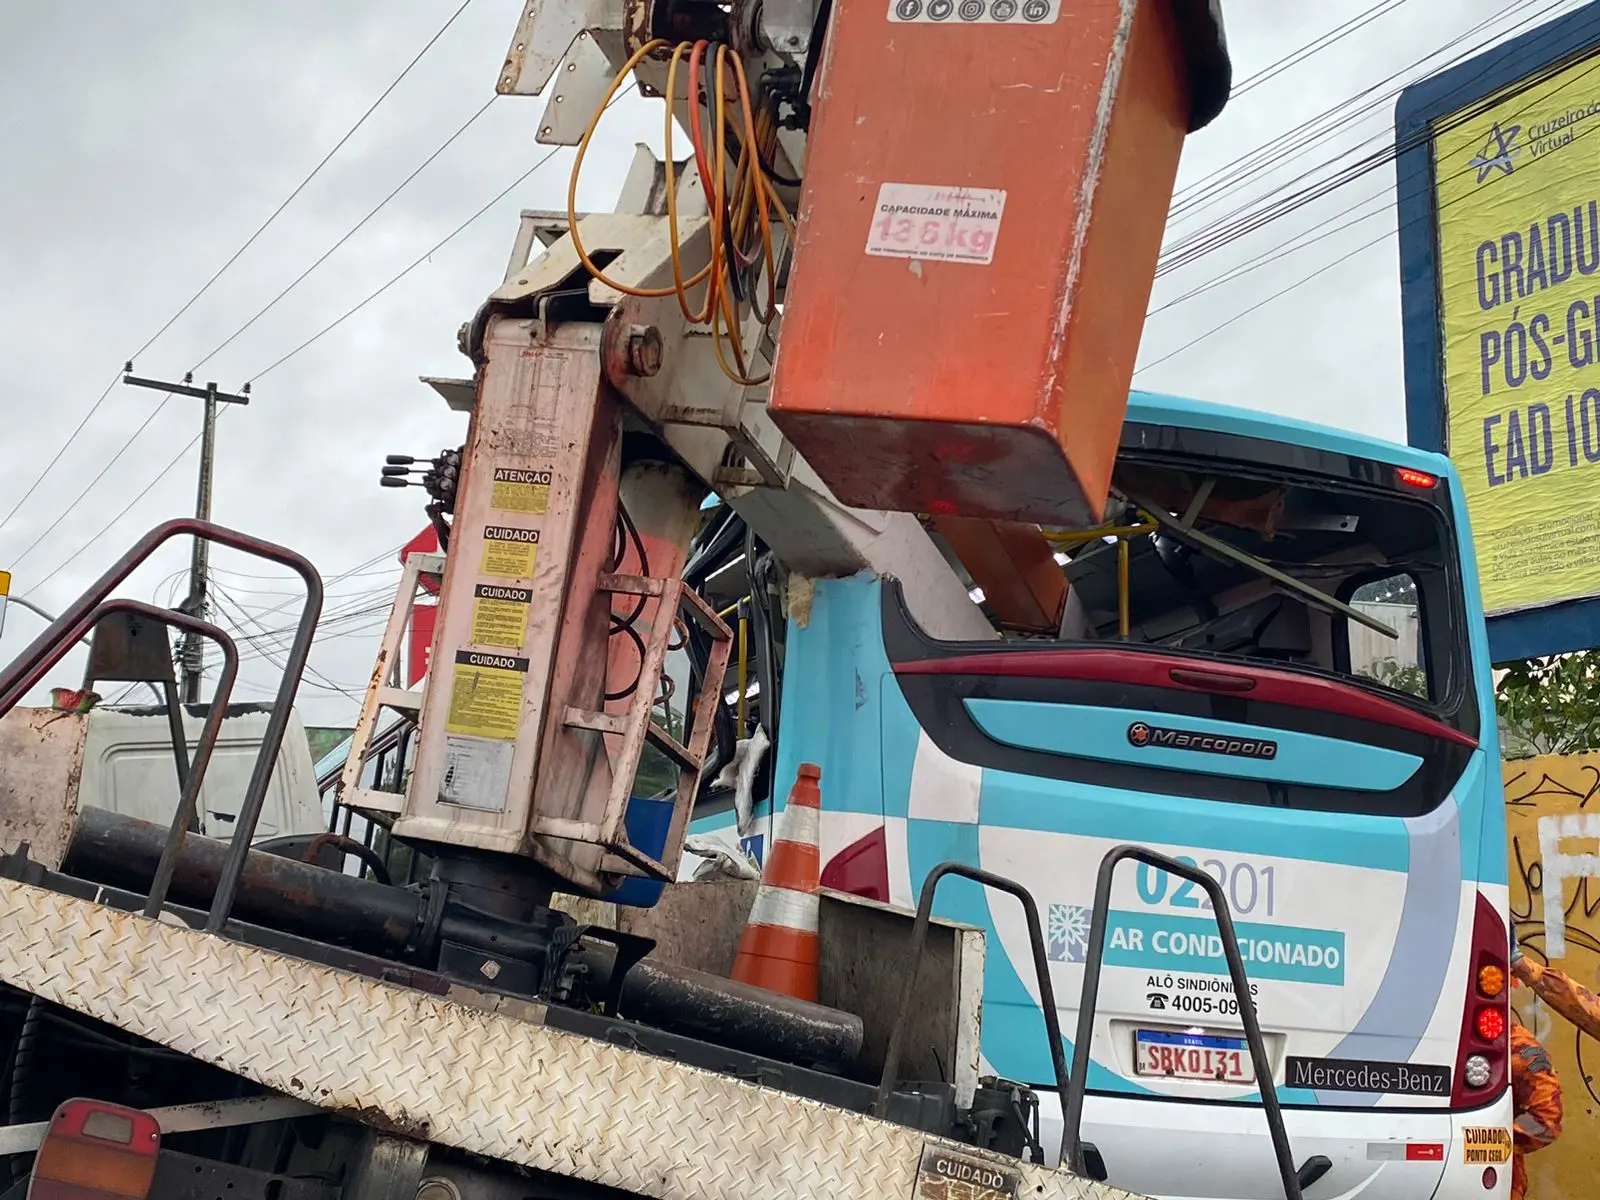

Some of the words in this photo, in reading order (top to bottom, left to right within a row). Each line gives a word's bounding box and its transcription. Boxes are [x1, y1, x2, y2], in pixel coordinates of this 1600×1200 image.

[1528, 109, 1585, 140] Cruzeiro
[1530, 127, 1574, 157] Virtual
[881, 204, 950, 217] CAPACIDADE
[953, 202, 998, 219] MÁXIMA
[1483, 403, 1554, 487] EAD
[485, 528, 539, 542] CUIDADO
[481, 587, 527, 600] CUIDADO
[469, 654, 516, 669] CUIDADO
[1151, 729, 1276, 756] Marcopolo
[1136, 856, 1275, 917] 02201
[1110, 927, 1144, 951] AR
[1152, 930, 1340, 969] CONDCIONADO
[1147, 974, 1174, 989] ALÔ
[1177, 977, 1258, 996] SINDIÔNIS
[1294, 1060, 1443, 1092] Mercedes-Benz
[1466, 1149, 1487, 1162] PONTO
[936, 1159, 1004, 1189] CUIDADO
